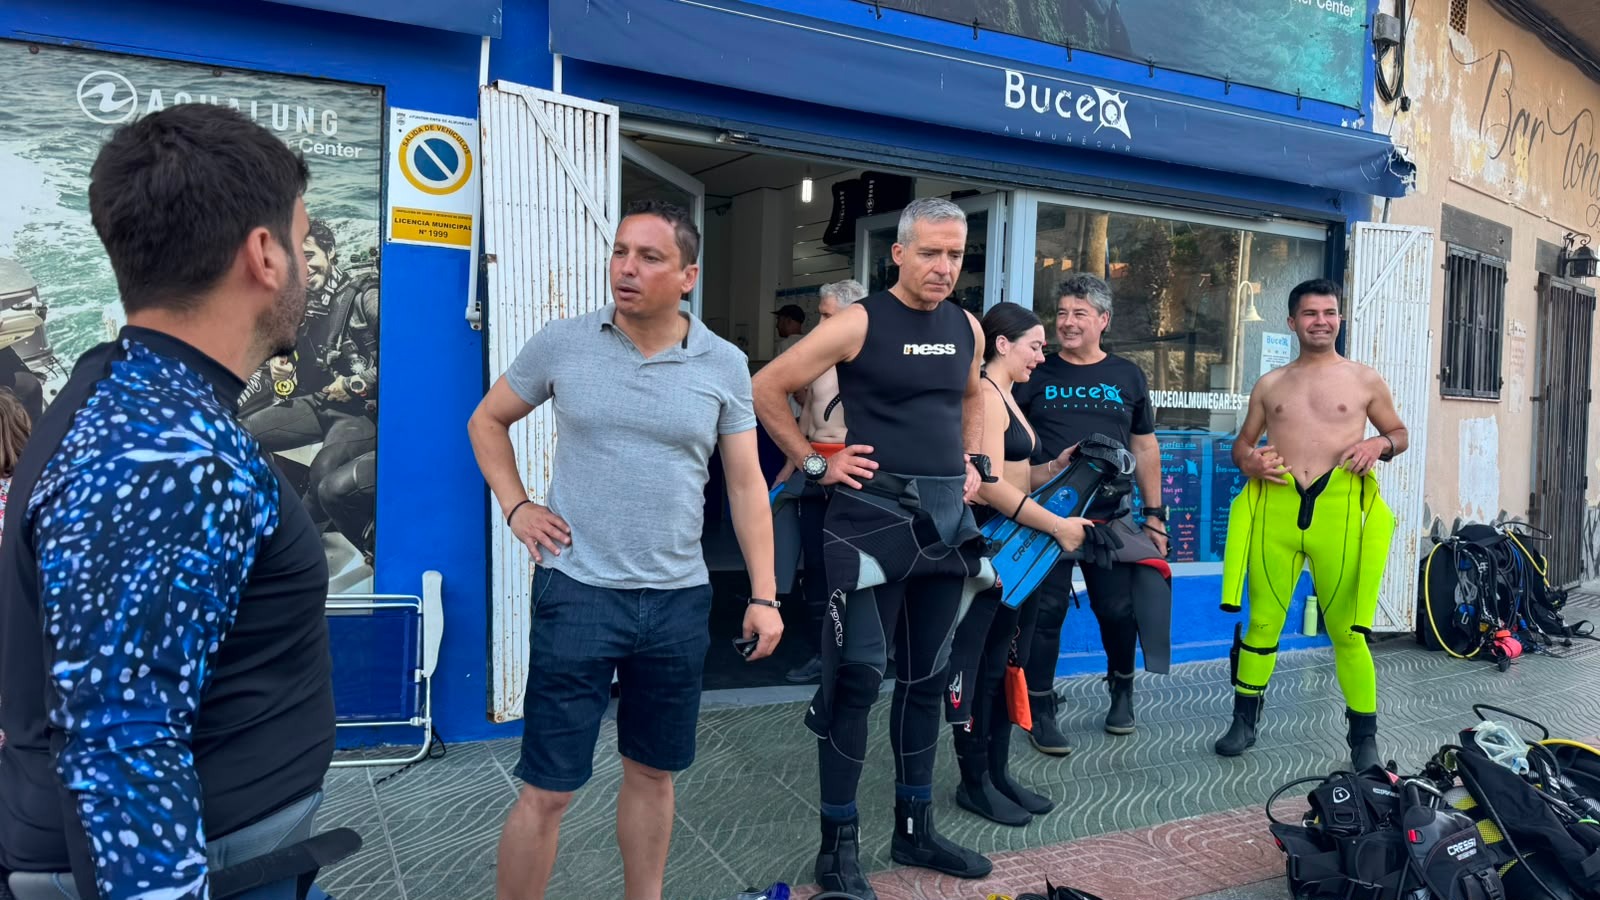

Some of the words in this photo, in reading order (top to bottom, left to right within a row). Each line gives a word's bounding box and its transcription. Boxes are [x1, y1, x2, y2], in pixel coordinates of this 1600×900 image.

[1316, 0, 1355, 17] Center
[1450, 39, 1545, 160] Bar
[1546, 105, 1600, 201] Ton
[402, 127, 424, 148] SALIDA
[299, 138, 363, 158] Center
[394, 217, 430, 227] LICENCIA
[431, 221, 472, 231] MUNICIPAL
[428, 230, 448, 238] 1999
[1447, 837, 1477, 856] CRESSI
